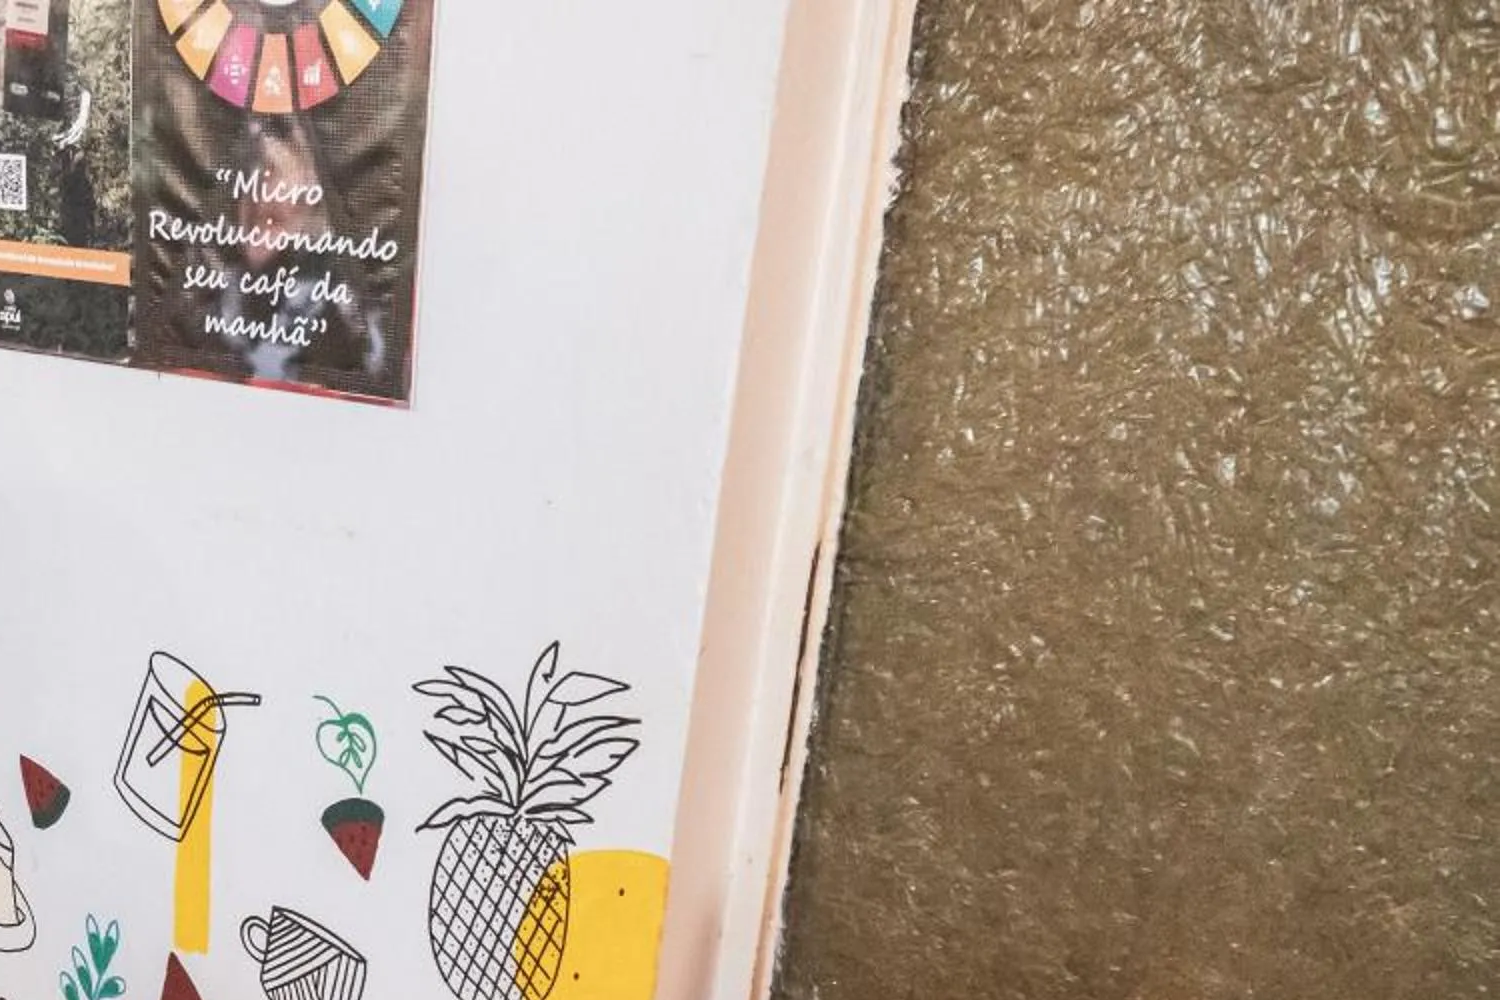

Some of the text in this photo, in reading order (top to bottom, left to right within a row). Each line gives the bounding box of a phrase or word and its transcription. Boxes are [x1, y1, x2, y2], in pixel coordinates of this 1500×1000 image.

[149, 209, 399, 262] Revolucionando
[183, 264, 352, 306] seu café da
